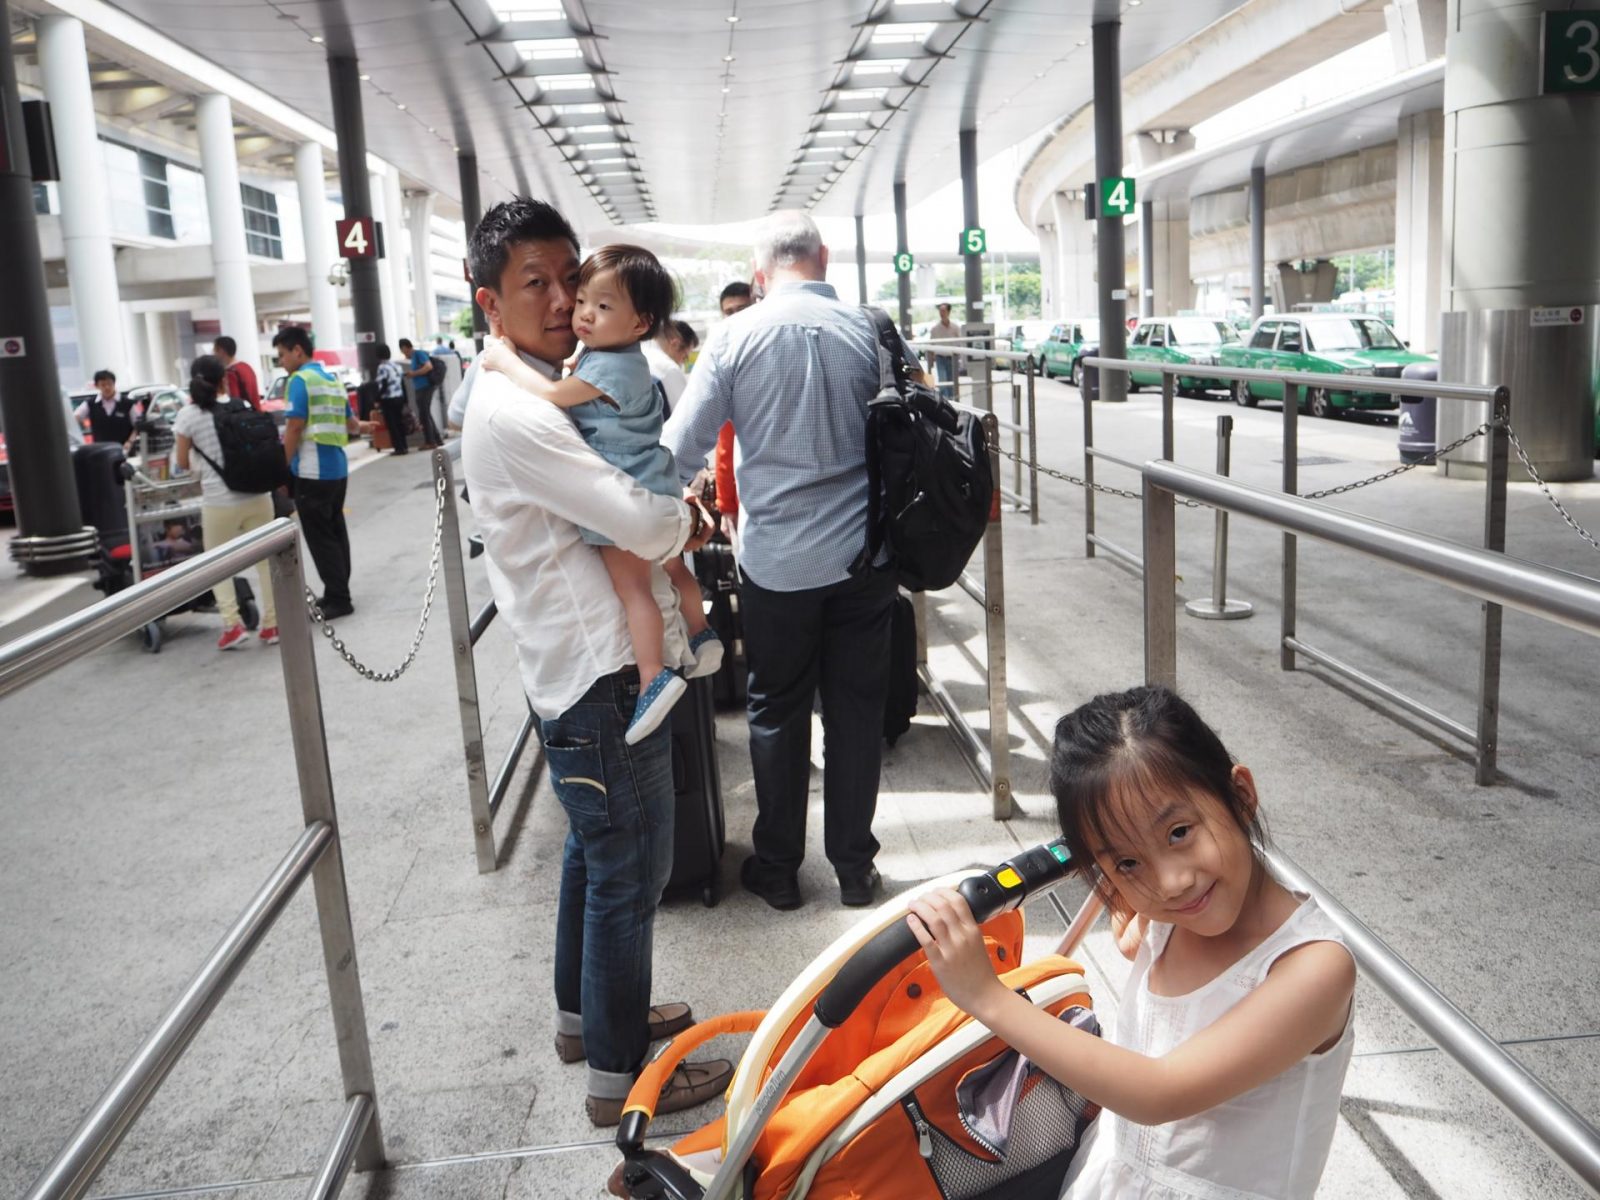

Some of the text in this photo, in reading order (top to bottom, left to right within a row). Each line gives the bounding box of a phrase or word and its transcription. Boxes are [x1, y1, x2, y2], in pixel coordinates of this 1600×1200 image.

[1563, 20, 1600, 83] 3
[1108, 181, 1129, 212] 4
[344, 221, 368, 254] 4
[967, 229, 983, 252] 5
[898, 254, 911, 272] 6
